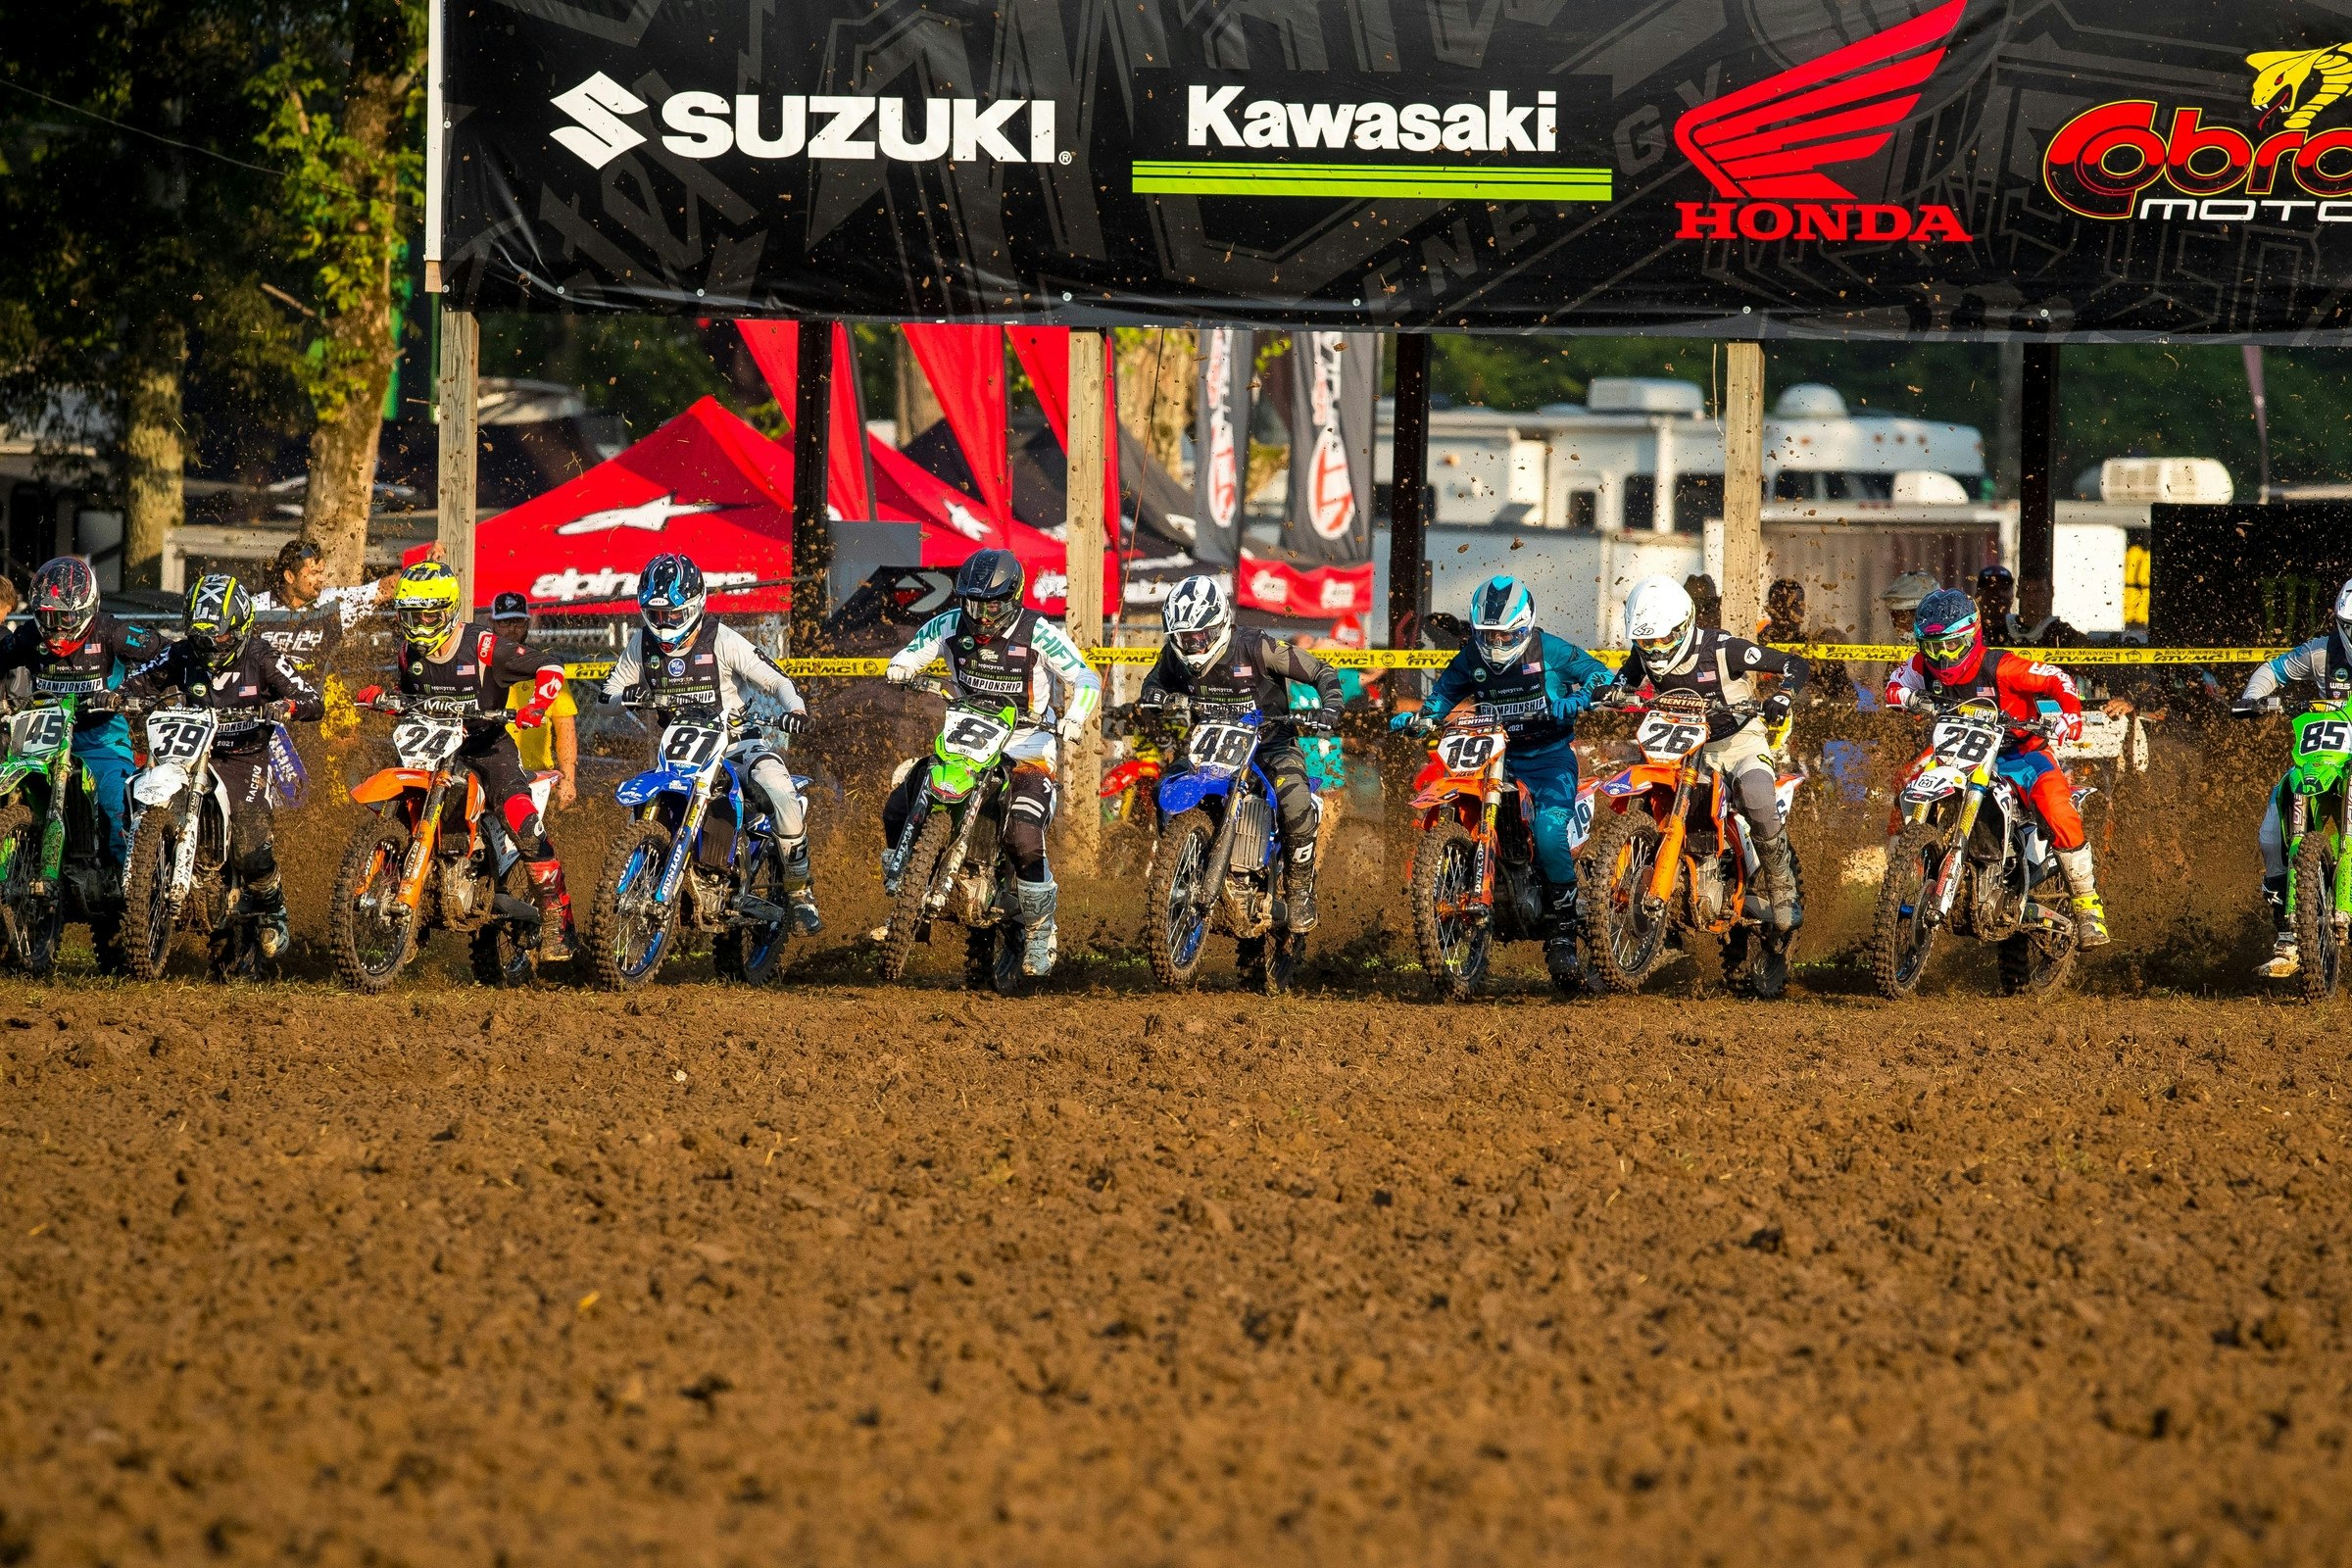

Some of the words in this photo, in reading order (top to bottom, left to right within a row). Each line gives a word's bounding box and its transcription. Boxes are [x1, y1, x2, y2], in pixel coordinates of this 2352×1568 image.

[662, 91, 1055, 163] SUZUKI
[1188, 84, 1556, 152] Kawasaki
[1675, 202, 1973, 242] HONDA
[906, 609, 962, 654] SHIFT
[38, 678, 102, 693] CHAMPIONSHIP
[960, 671, 1022, 692] CHAMPIONSHIP
[1481, 697, 1545, 716] CHAMPIONSHIP
[1659, 698, 1710, 709] RENTHAL
[1458, 717, 1494, 726] RENTHAL
[1641, 723, 1701, 754] 26
[2299, 720, 2348, 755] 85
[153, 723, 206, 758] 39
[399, 727, 447, 760] 24
[665, 727, 720, 764] 81
[1446, 736, 1494, 769] 19
[1935, 726, 1995, 762] 28
[661, 843, 684, 896] DUNLOP
